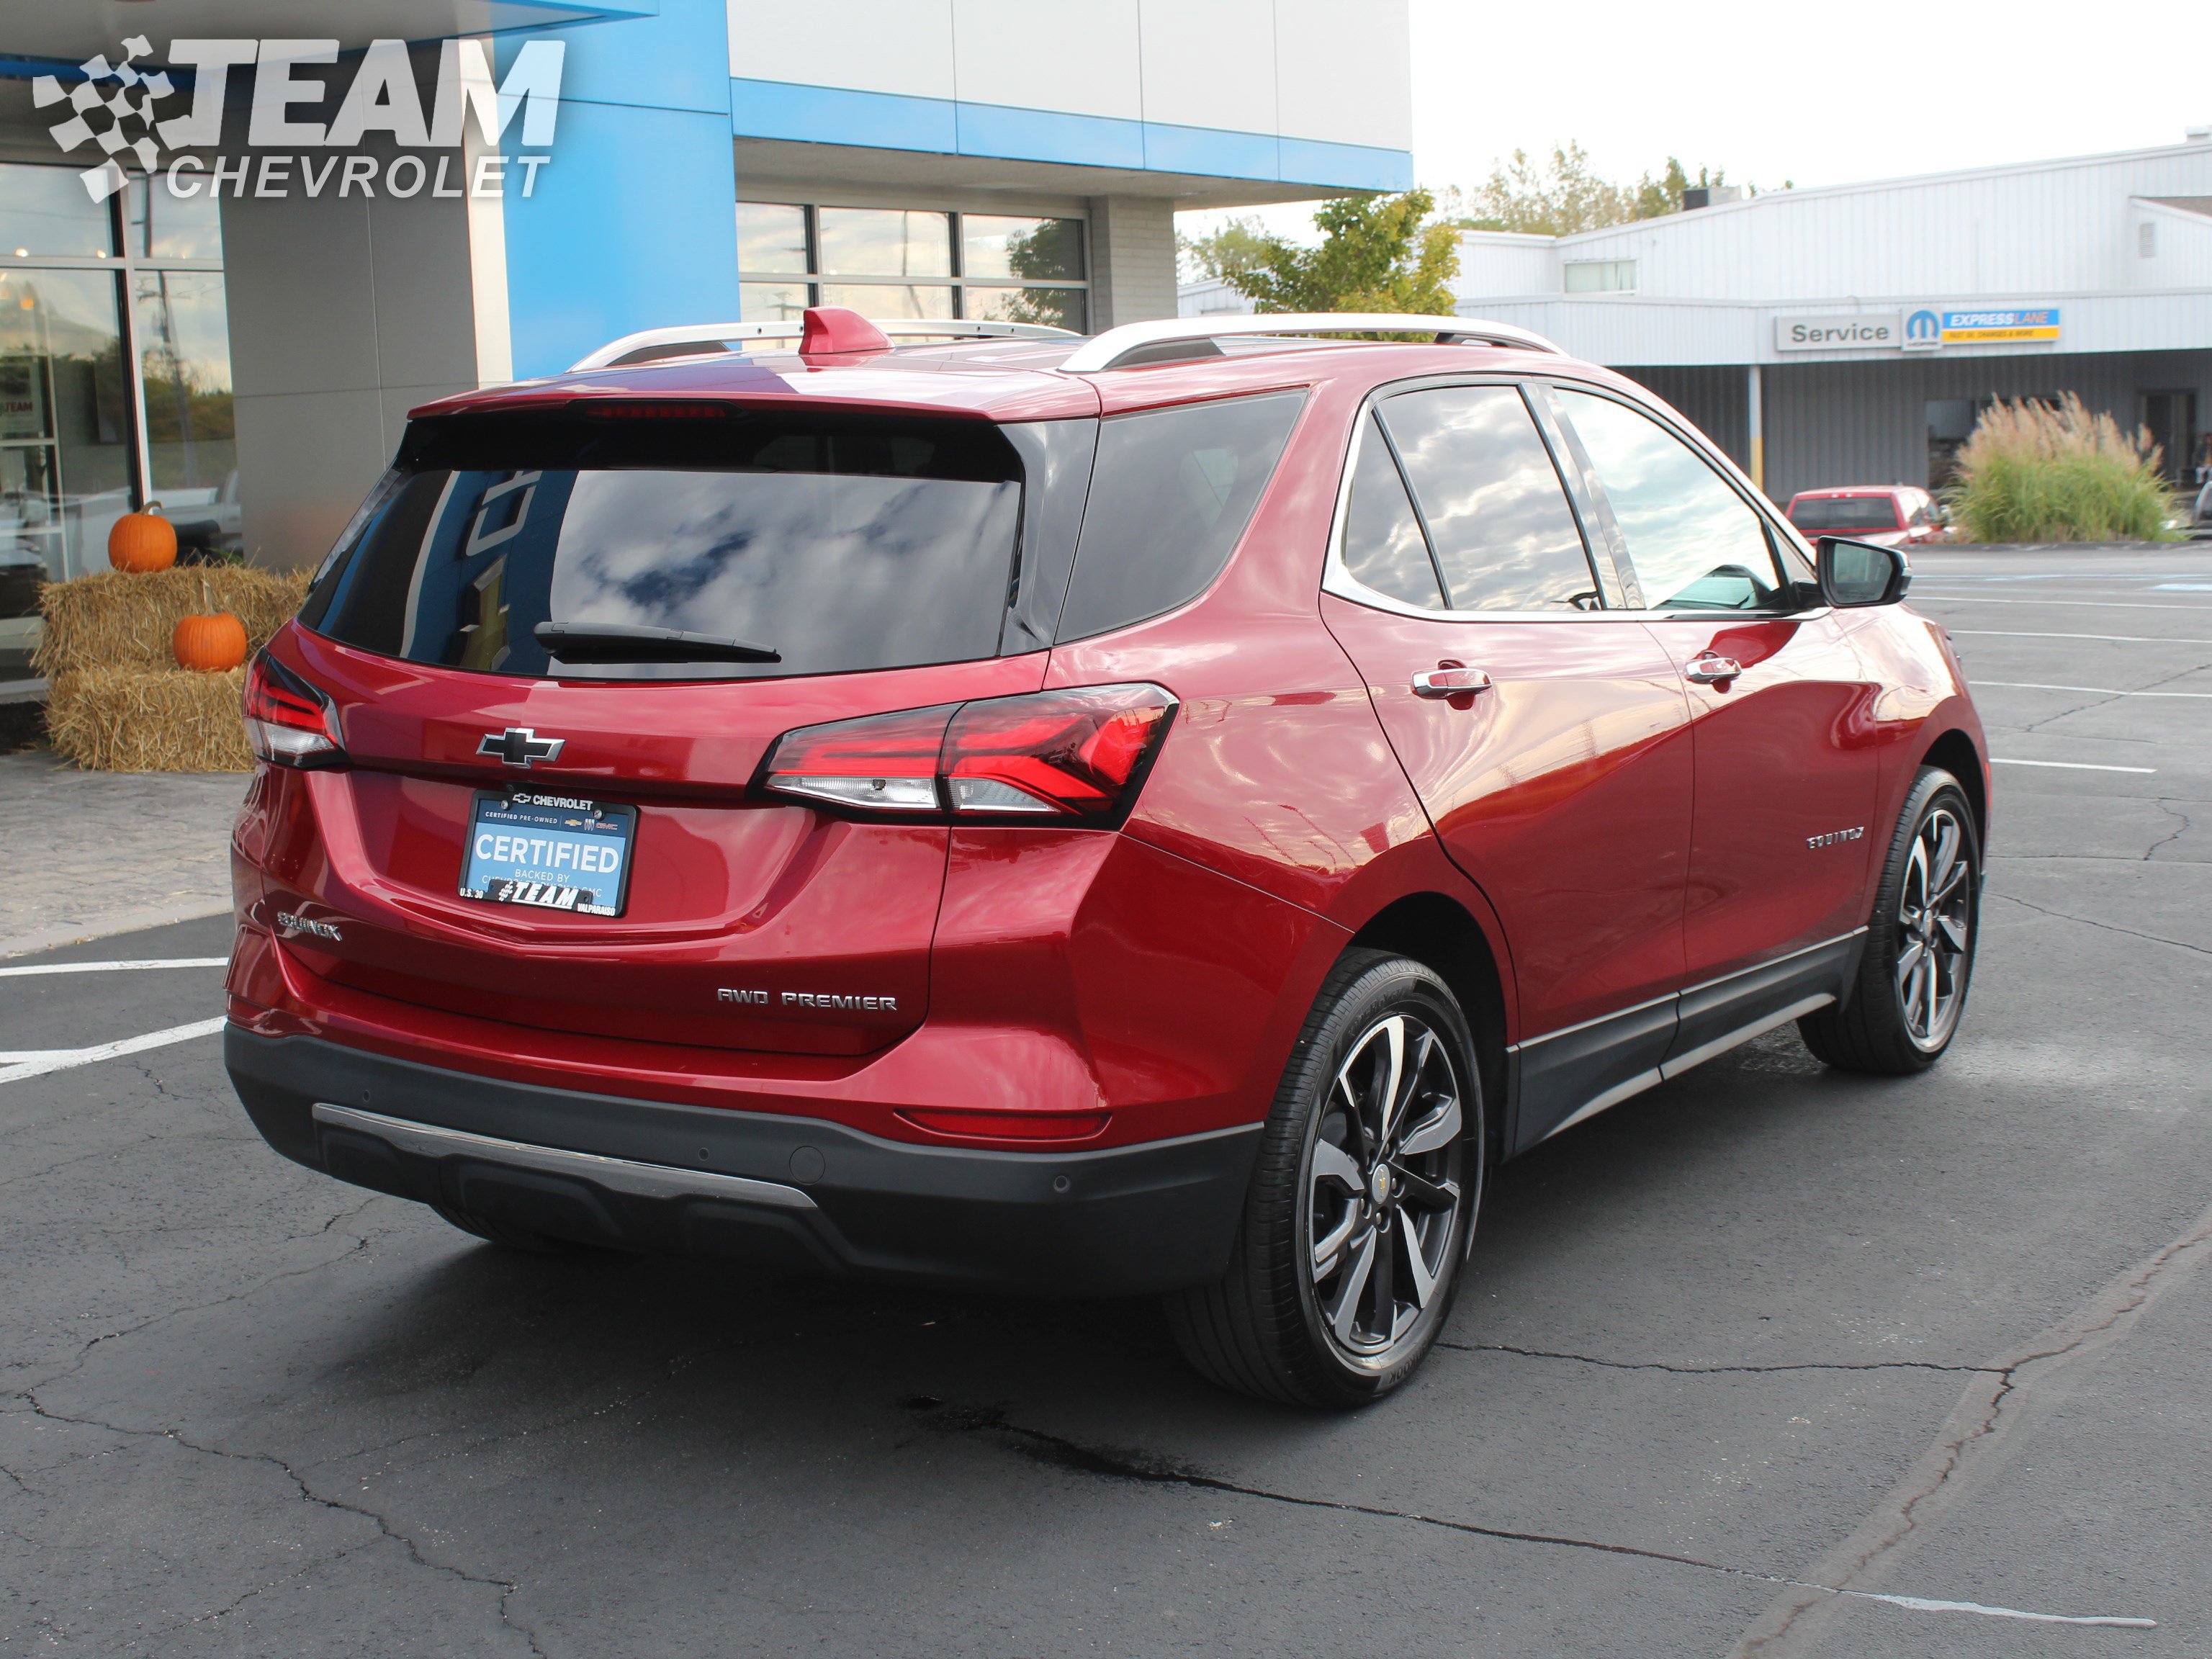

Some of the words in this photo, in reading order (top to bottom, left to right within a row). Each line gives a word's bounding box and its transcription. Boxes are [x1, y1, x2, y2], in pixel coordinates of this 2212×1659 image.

[1791, 323, 1889, 343] Service
[533, 794, 593, 811] CHEVROLET
[485, 811, 518, 820] CERTIFIED
[520, 814, 558, 824] PRE-OWNED
[475, 834, 619, 873] CERTIFIED
[515, 868, 554, 881] BACKED
[557, 873, 570, 883] BY
[459, 887, 474, 898] U.S.
[475, 889, 484, 899] 30
[512, 881, 579, 906] TEAM
[577, 902, 616, 917] VALPARAISO
[717, 988, 768, 1004] AWD
[781, 992, 897, 1011] PREMIER
